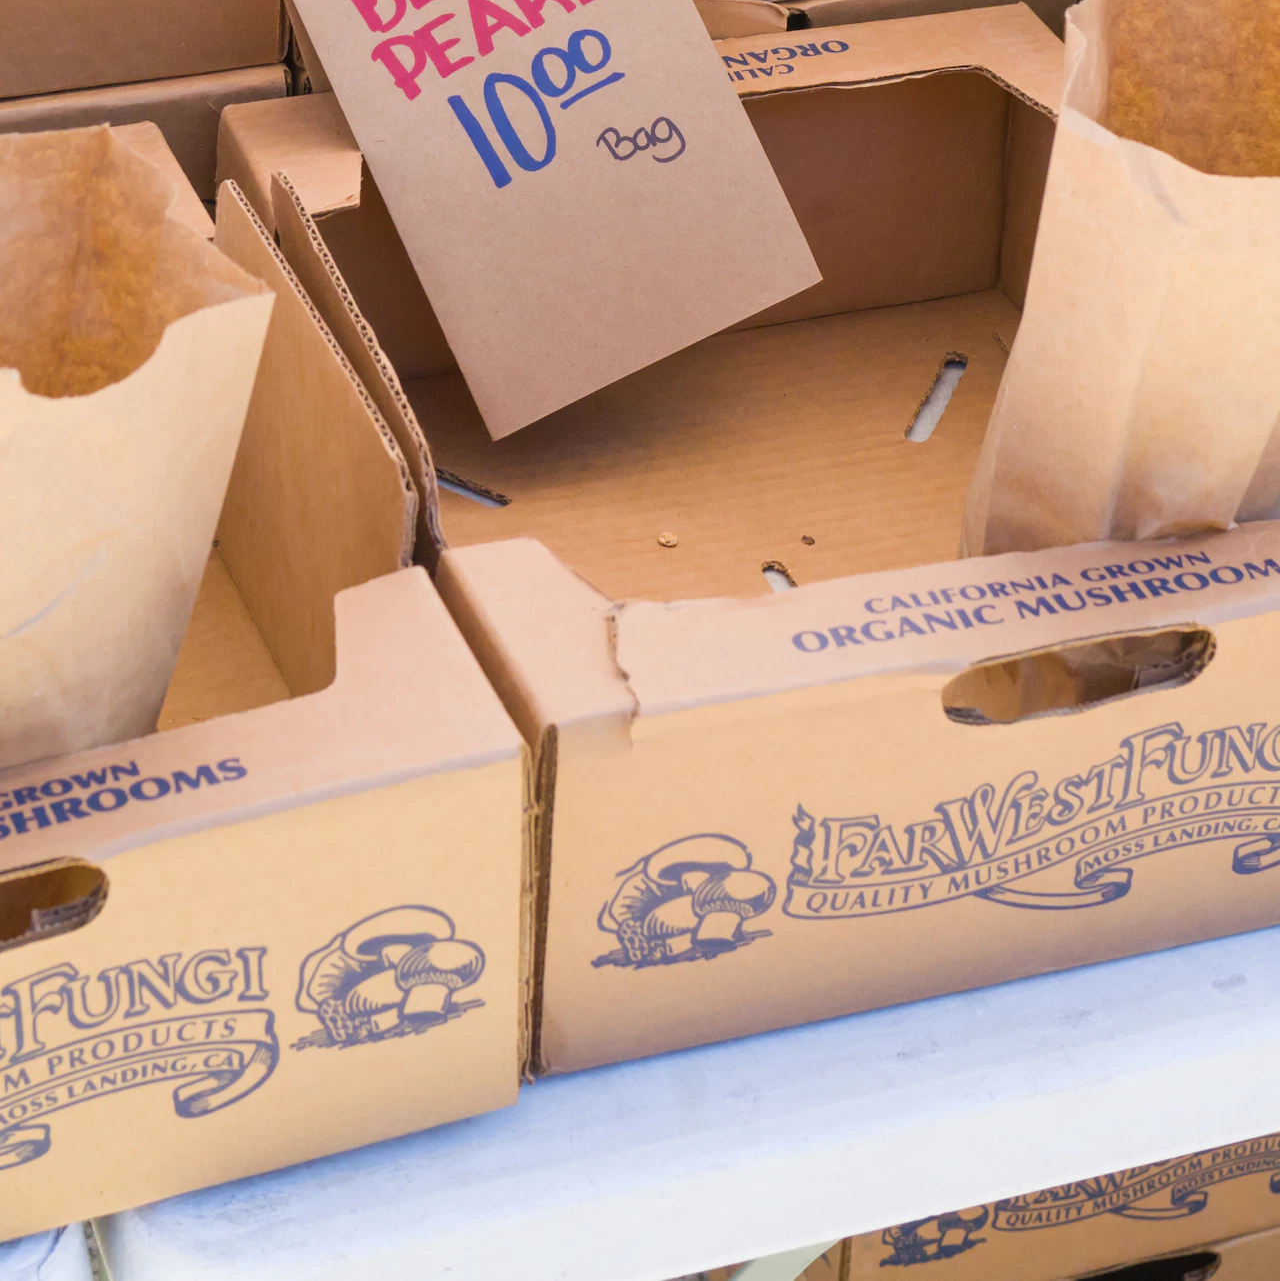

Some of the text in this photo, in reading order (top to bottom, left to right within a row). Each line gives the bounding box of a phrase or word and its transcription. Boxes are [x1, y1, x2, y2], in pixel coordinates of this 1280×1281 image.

[721, 41, 849, 69] ORGAN
[596, 116, 686, 163] Bag
[863, 551, 1213, 615] CALIFORNIA GROWN
[792, 603, 1006, 653] ORGANIC
[805, 881, 934, 913] QUALITY
[946, 814, 1129, 893] MUSHROOM
[1082, 840, 1147, 873] MOSS
[46, 1017, 238, 1075] PRODUCTS
[203, 1053, 237, 1070] CA
[1006, 1203, 1085, 1227] QUALITY
[1092, 1158, 1203, 1213] MUSHROOM
[1174, 1173, 1215, 1197] MOSS
